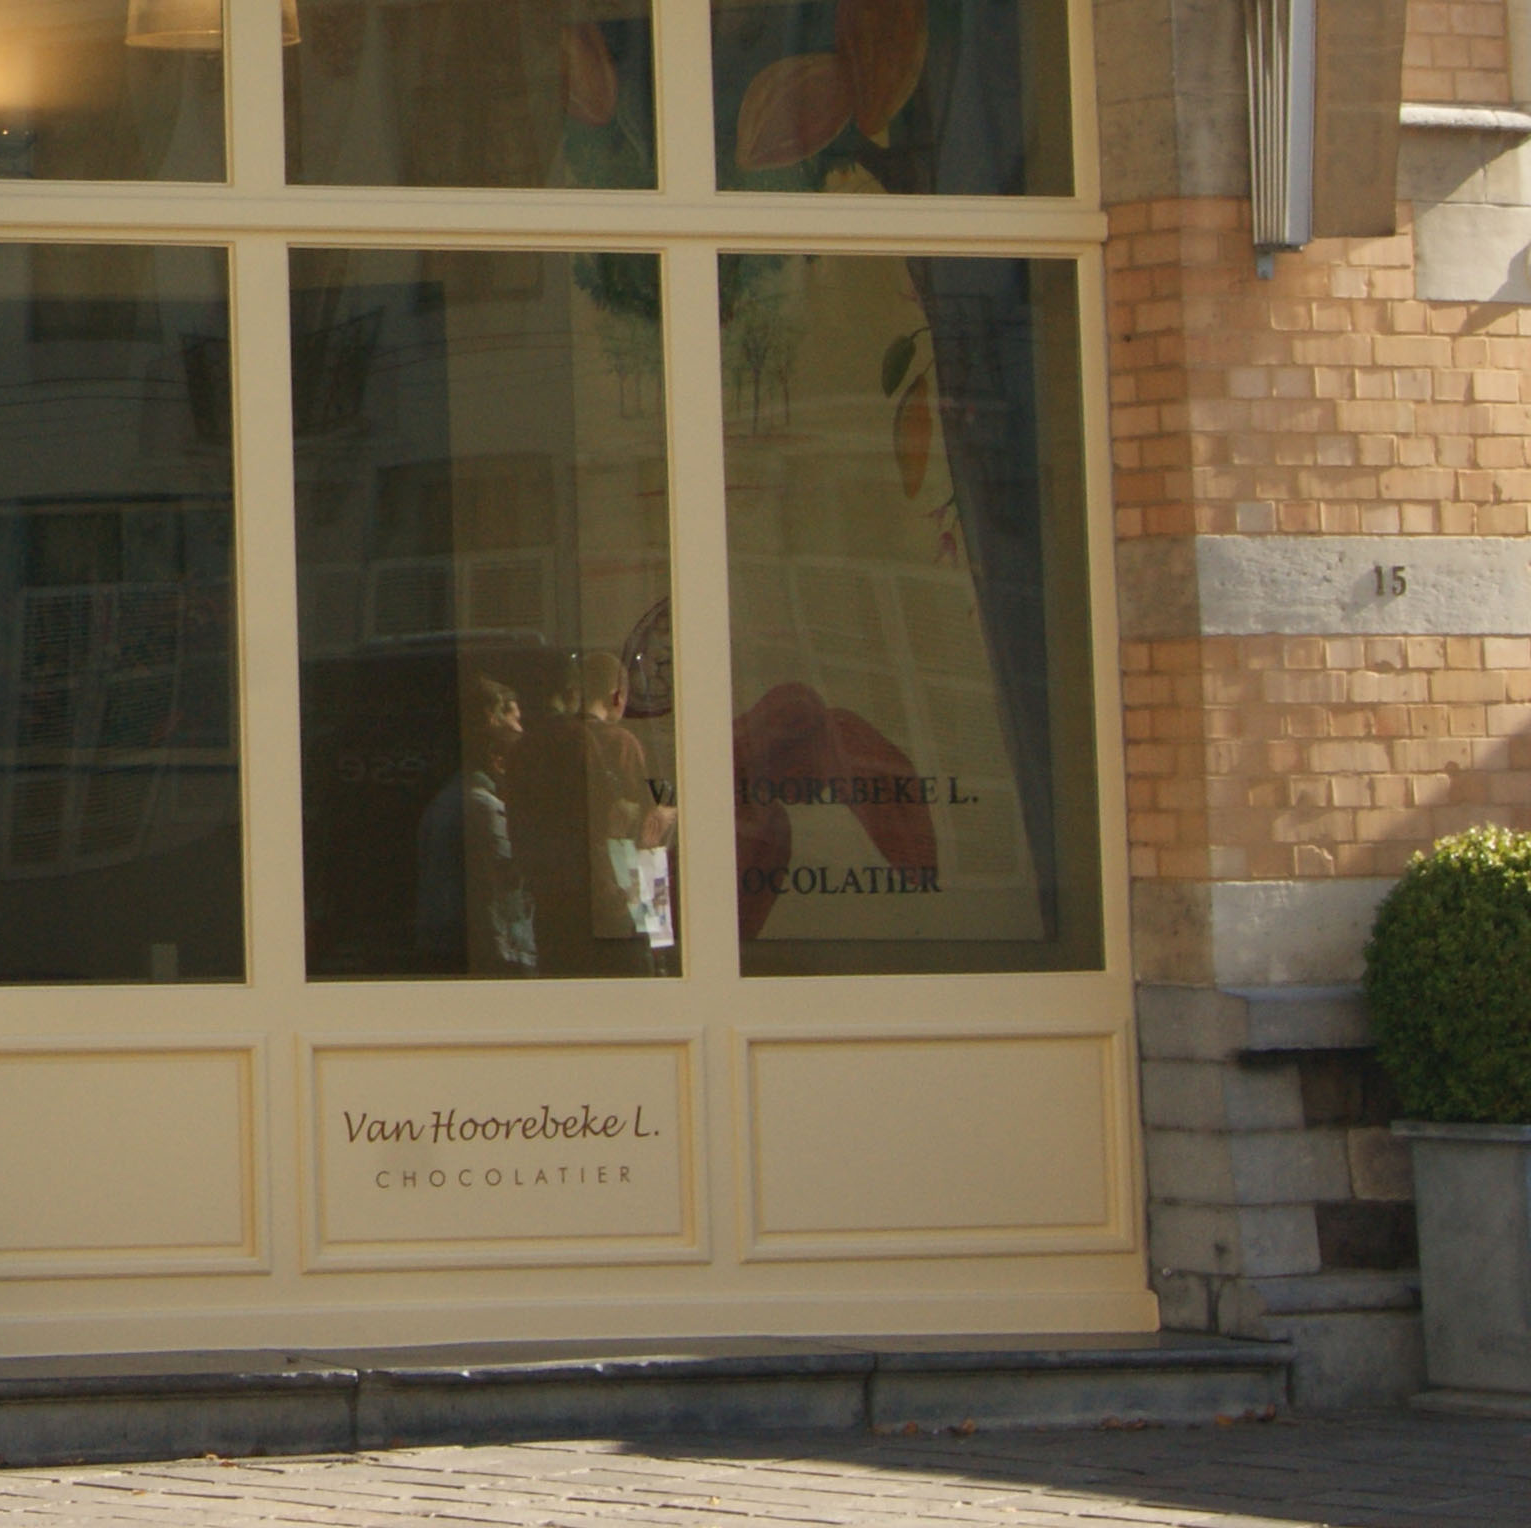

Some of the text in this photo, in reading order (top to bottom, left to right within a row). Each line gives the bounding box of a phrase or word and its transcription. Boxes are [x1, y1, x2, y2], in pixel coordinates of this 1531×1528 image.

[1372, 564, 1408, 597] 15
[948, 776, 980, 804] L.
[343, 1104, 661, 1144] Van Hoorebeke L.
[375, 1165, 633, 1189] CHOCOLATIER
